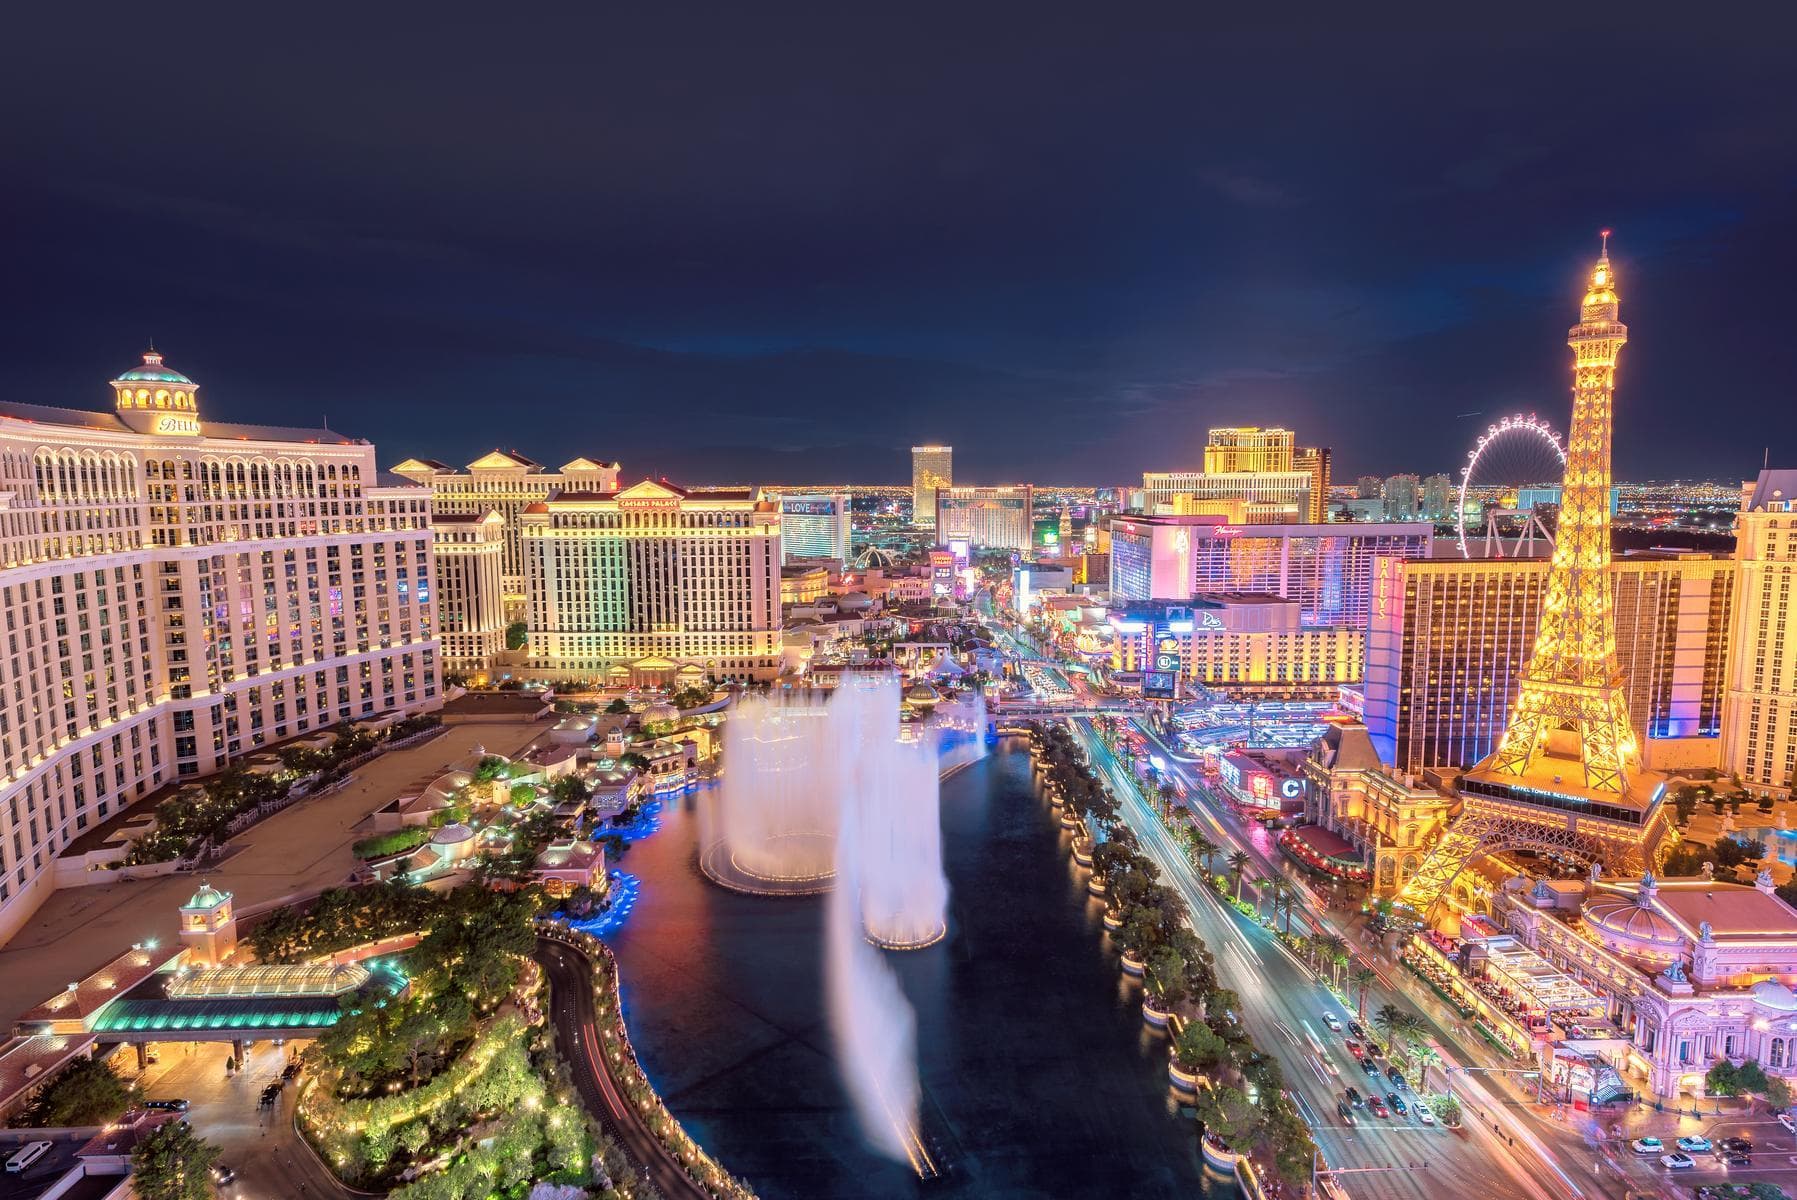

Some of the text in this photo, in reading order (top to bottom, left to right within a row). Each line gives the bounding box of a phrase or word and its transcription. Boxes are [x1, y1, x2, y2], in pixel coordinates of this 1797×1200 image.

[791, 503, 810, 513] LOVE
[1511, 784, 1589, 803] EIFFEL TOWER RESTAURANT
